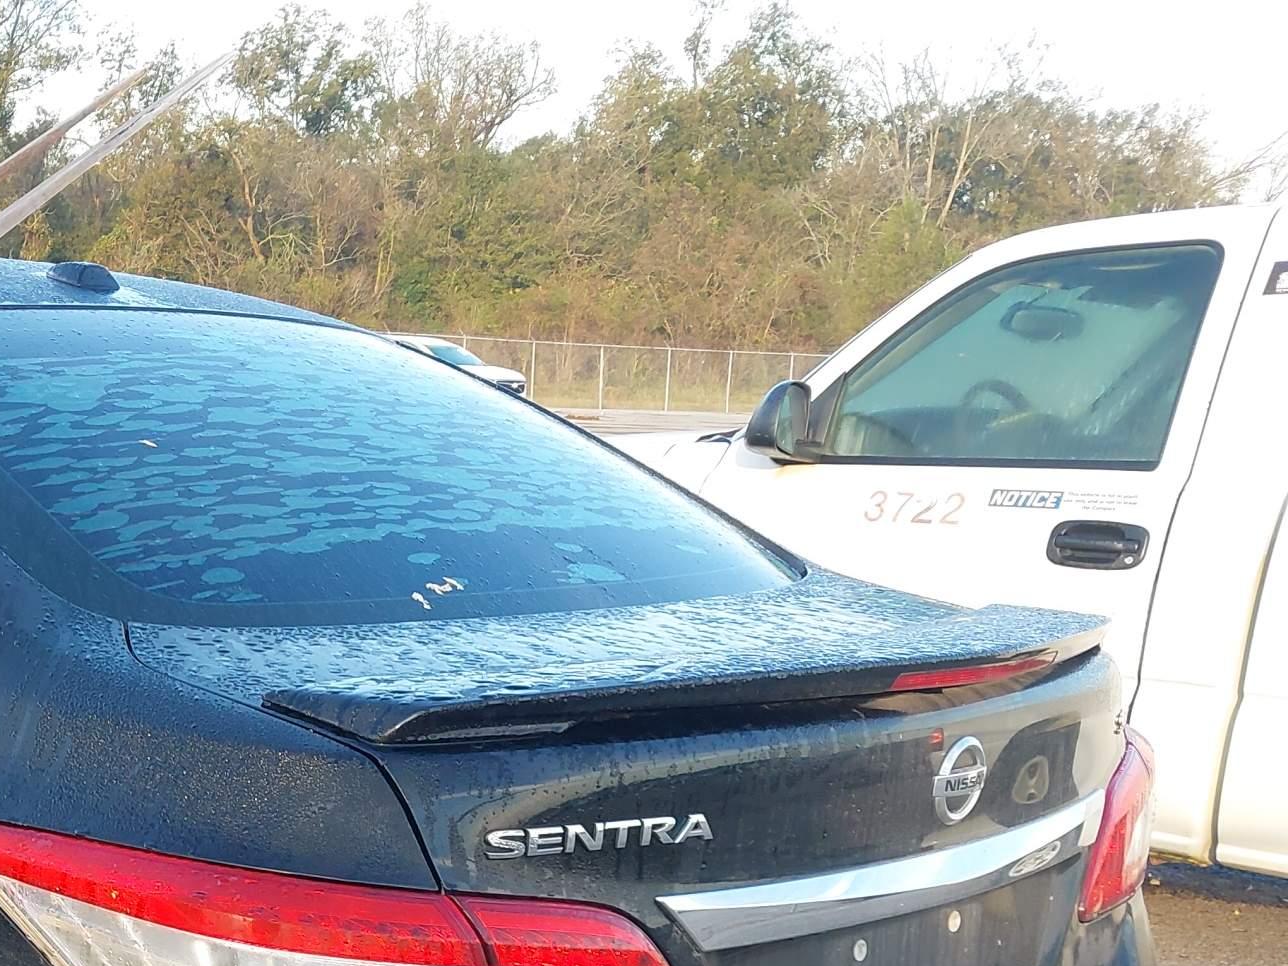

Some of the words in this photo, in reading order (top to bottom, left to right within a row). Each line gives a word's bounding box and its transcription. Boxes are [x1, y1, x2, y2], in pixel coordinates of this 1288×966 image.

[864, 490, 966, 525] 3722
[989, 489, 1064, 509] NOTICE
[485, 813, 714, 860] SENTRA
